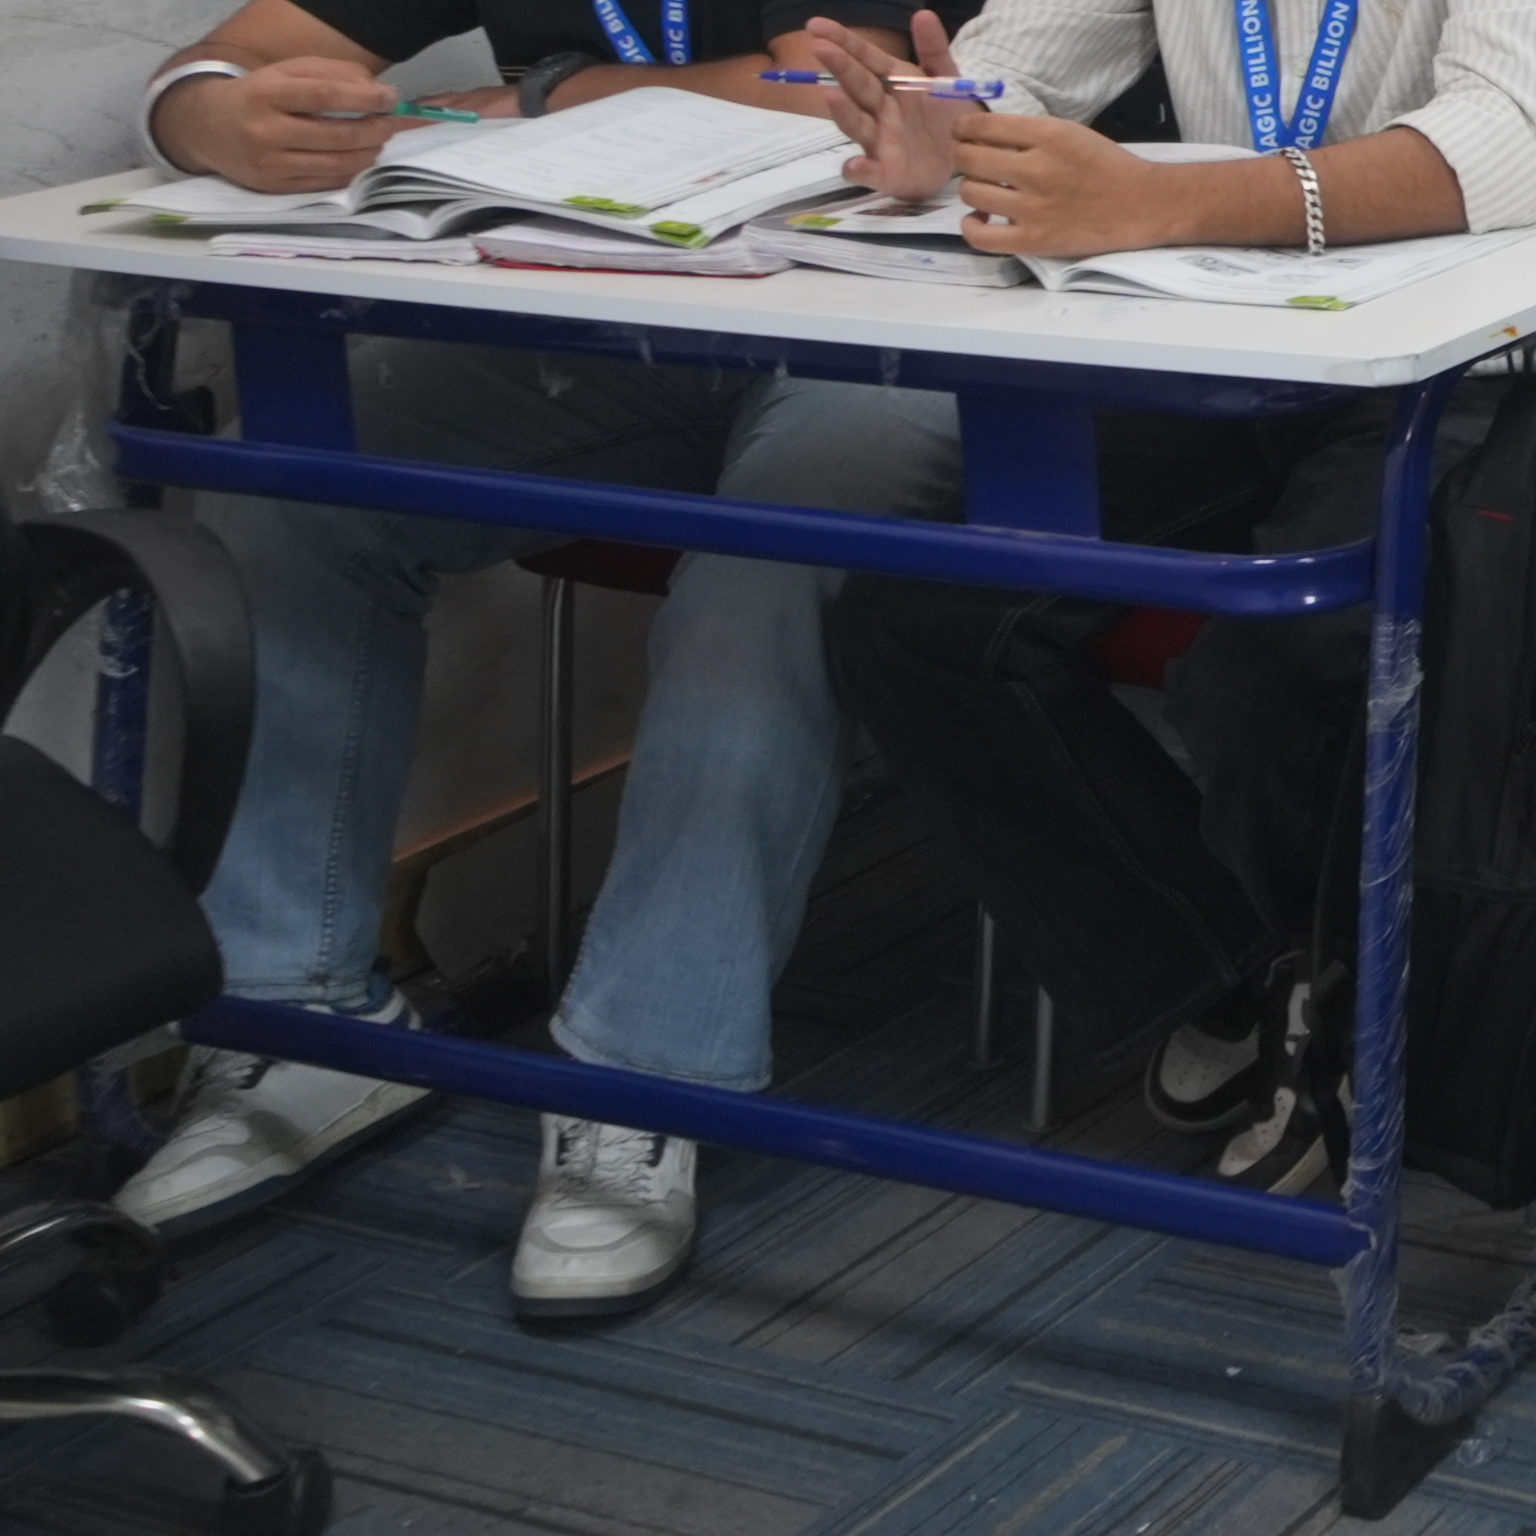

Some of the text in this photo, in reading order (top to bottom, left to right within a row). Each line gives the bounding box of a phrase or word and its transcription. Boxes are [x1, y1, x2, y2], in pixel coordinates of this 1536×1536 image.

[1253, 92, 1278, 154] AGIC
[1296, 2, 1350, 150] AGIC BILLION
